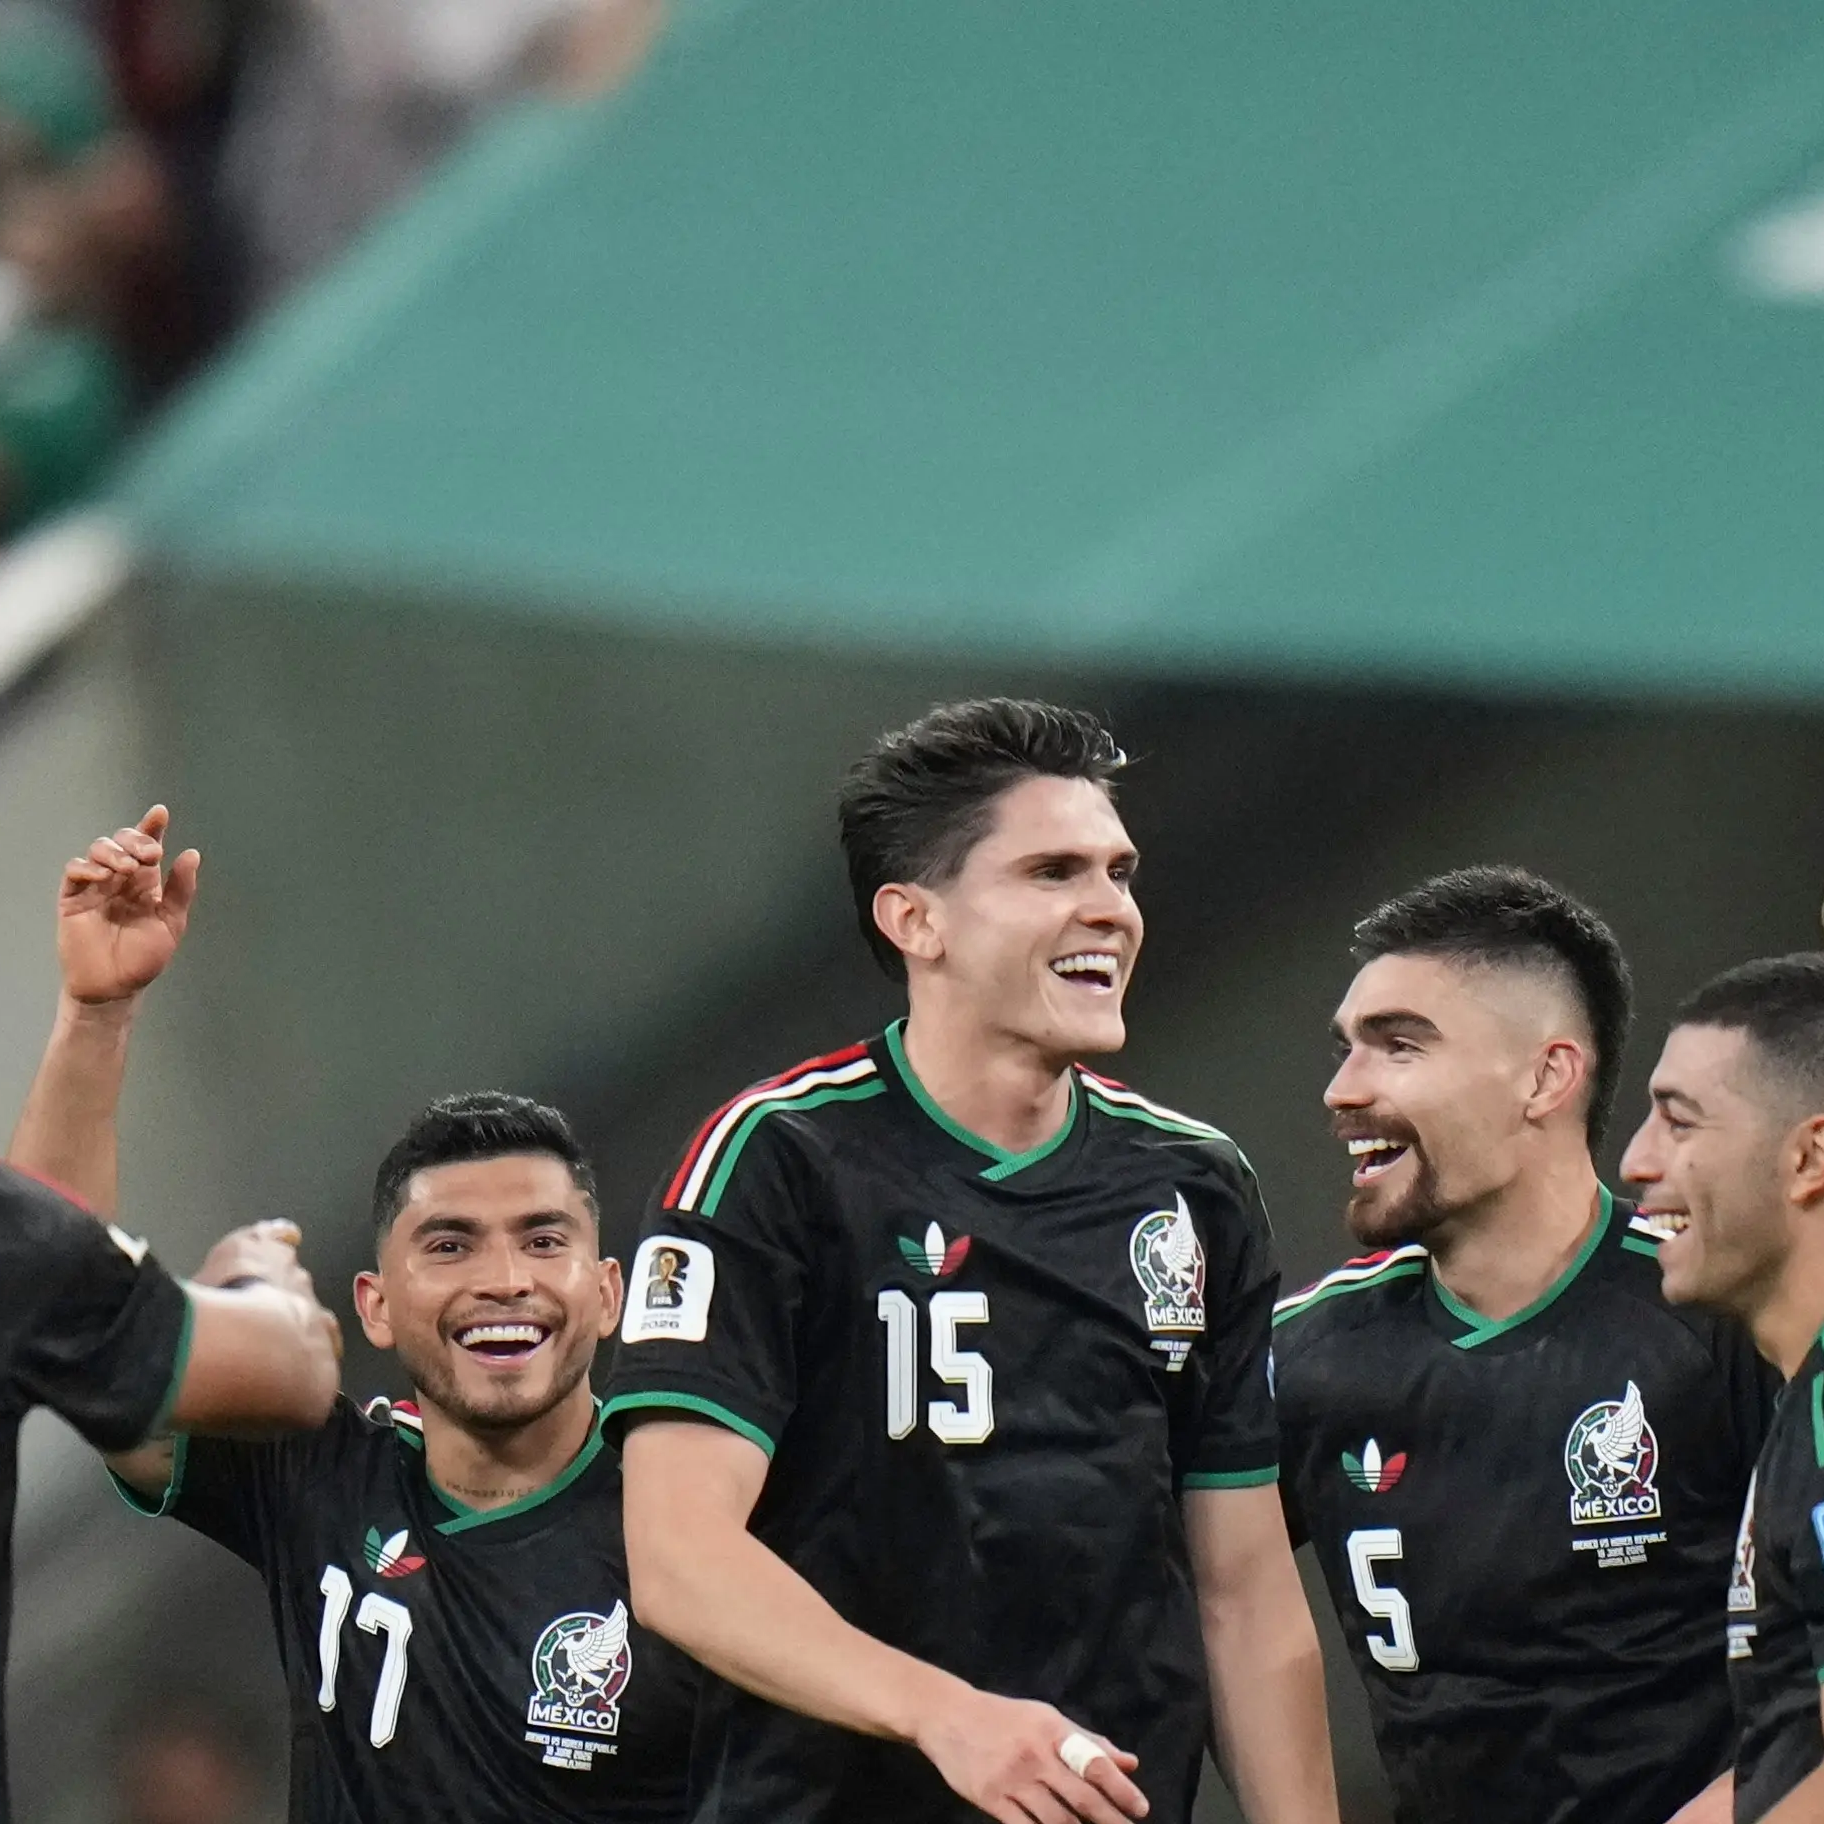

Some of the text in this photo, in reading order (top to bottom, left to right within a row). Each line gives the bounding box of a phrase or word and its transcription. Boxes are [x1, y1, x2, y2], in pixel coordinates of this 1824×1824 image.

[1150, 1302, 1204, 1325] MÉXICO
[877, 1290, 994, 1444] 15
[1574, 1496, 1655, 1519] MÉXICO
[1346, 1528, 1419, 1671] 5
[319, 1565, 413, 1748] 17
[533, 1702, 614, 1730] MÉXICO
